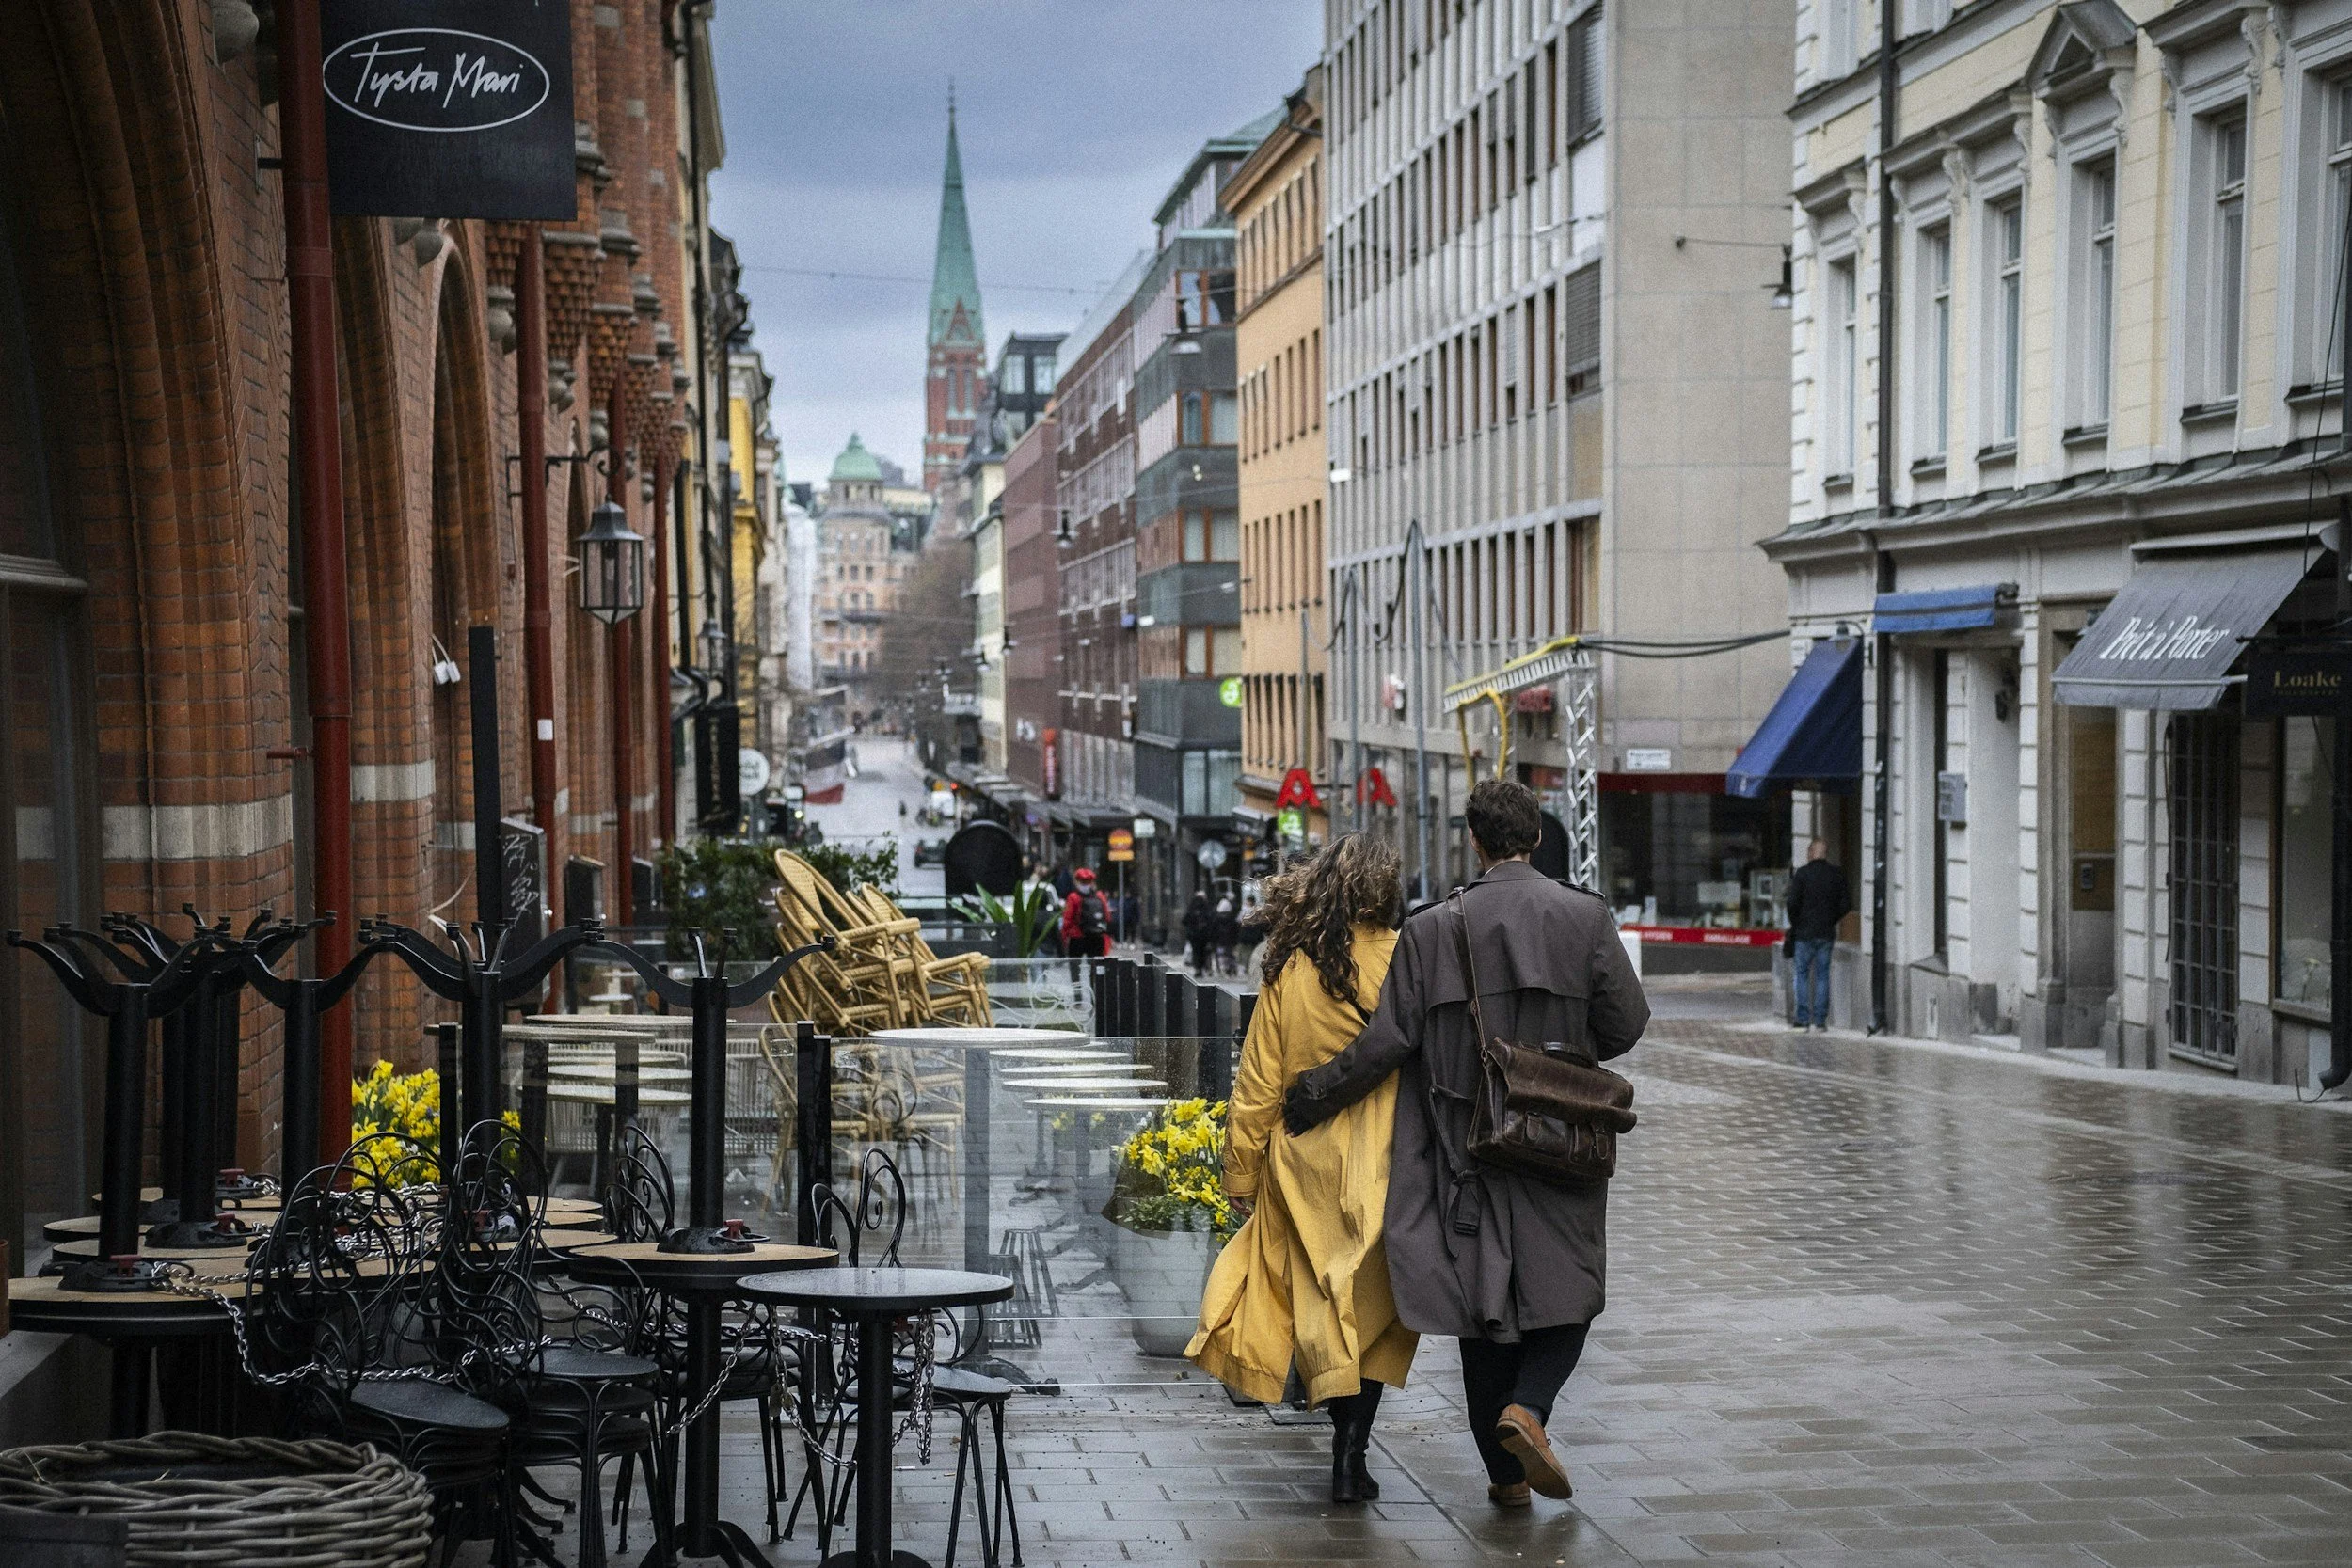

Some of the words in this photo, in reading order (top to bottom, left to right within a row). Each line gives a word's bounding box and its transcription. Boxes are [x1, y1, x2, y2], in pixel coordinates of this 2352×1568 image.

[350, 41, 439, 108] Tysta
[442, 52, 524, 109] Mari
[2153, 616, 2230, 659] Porter
[2274, 670, 2342, 688] Loake
